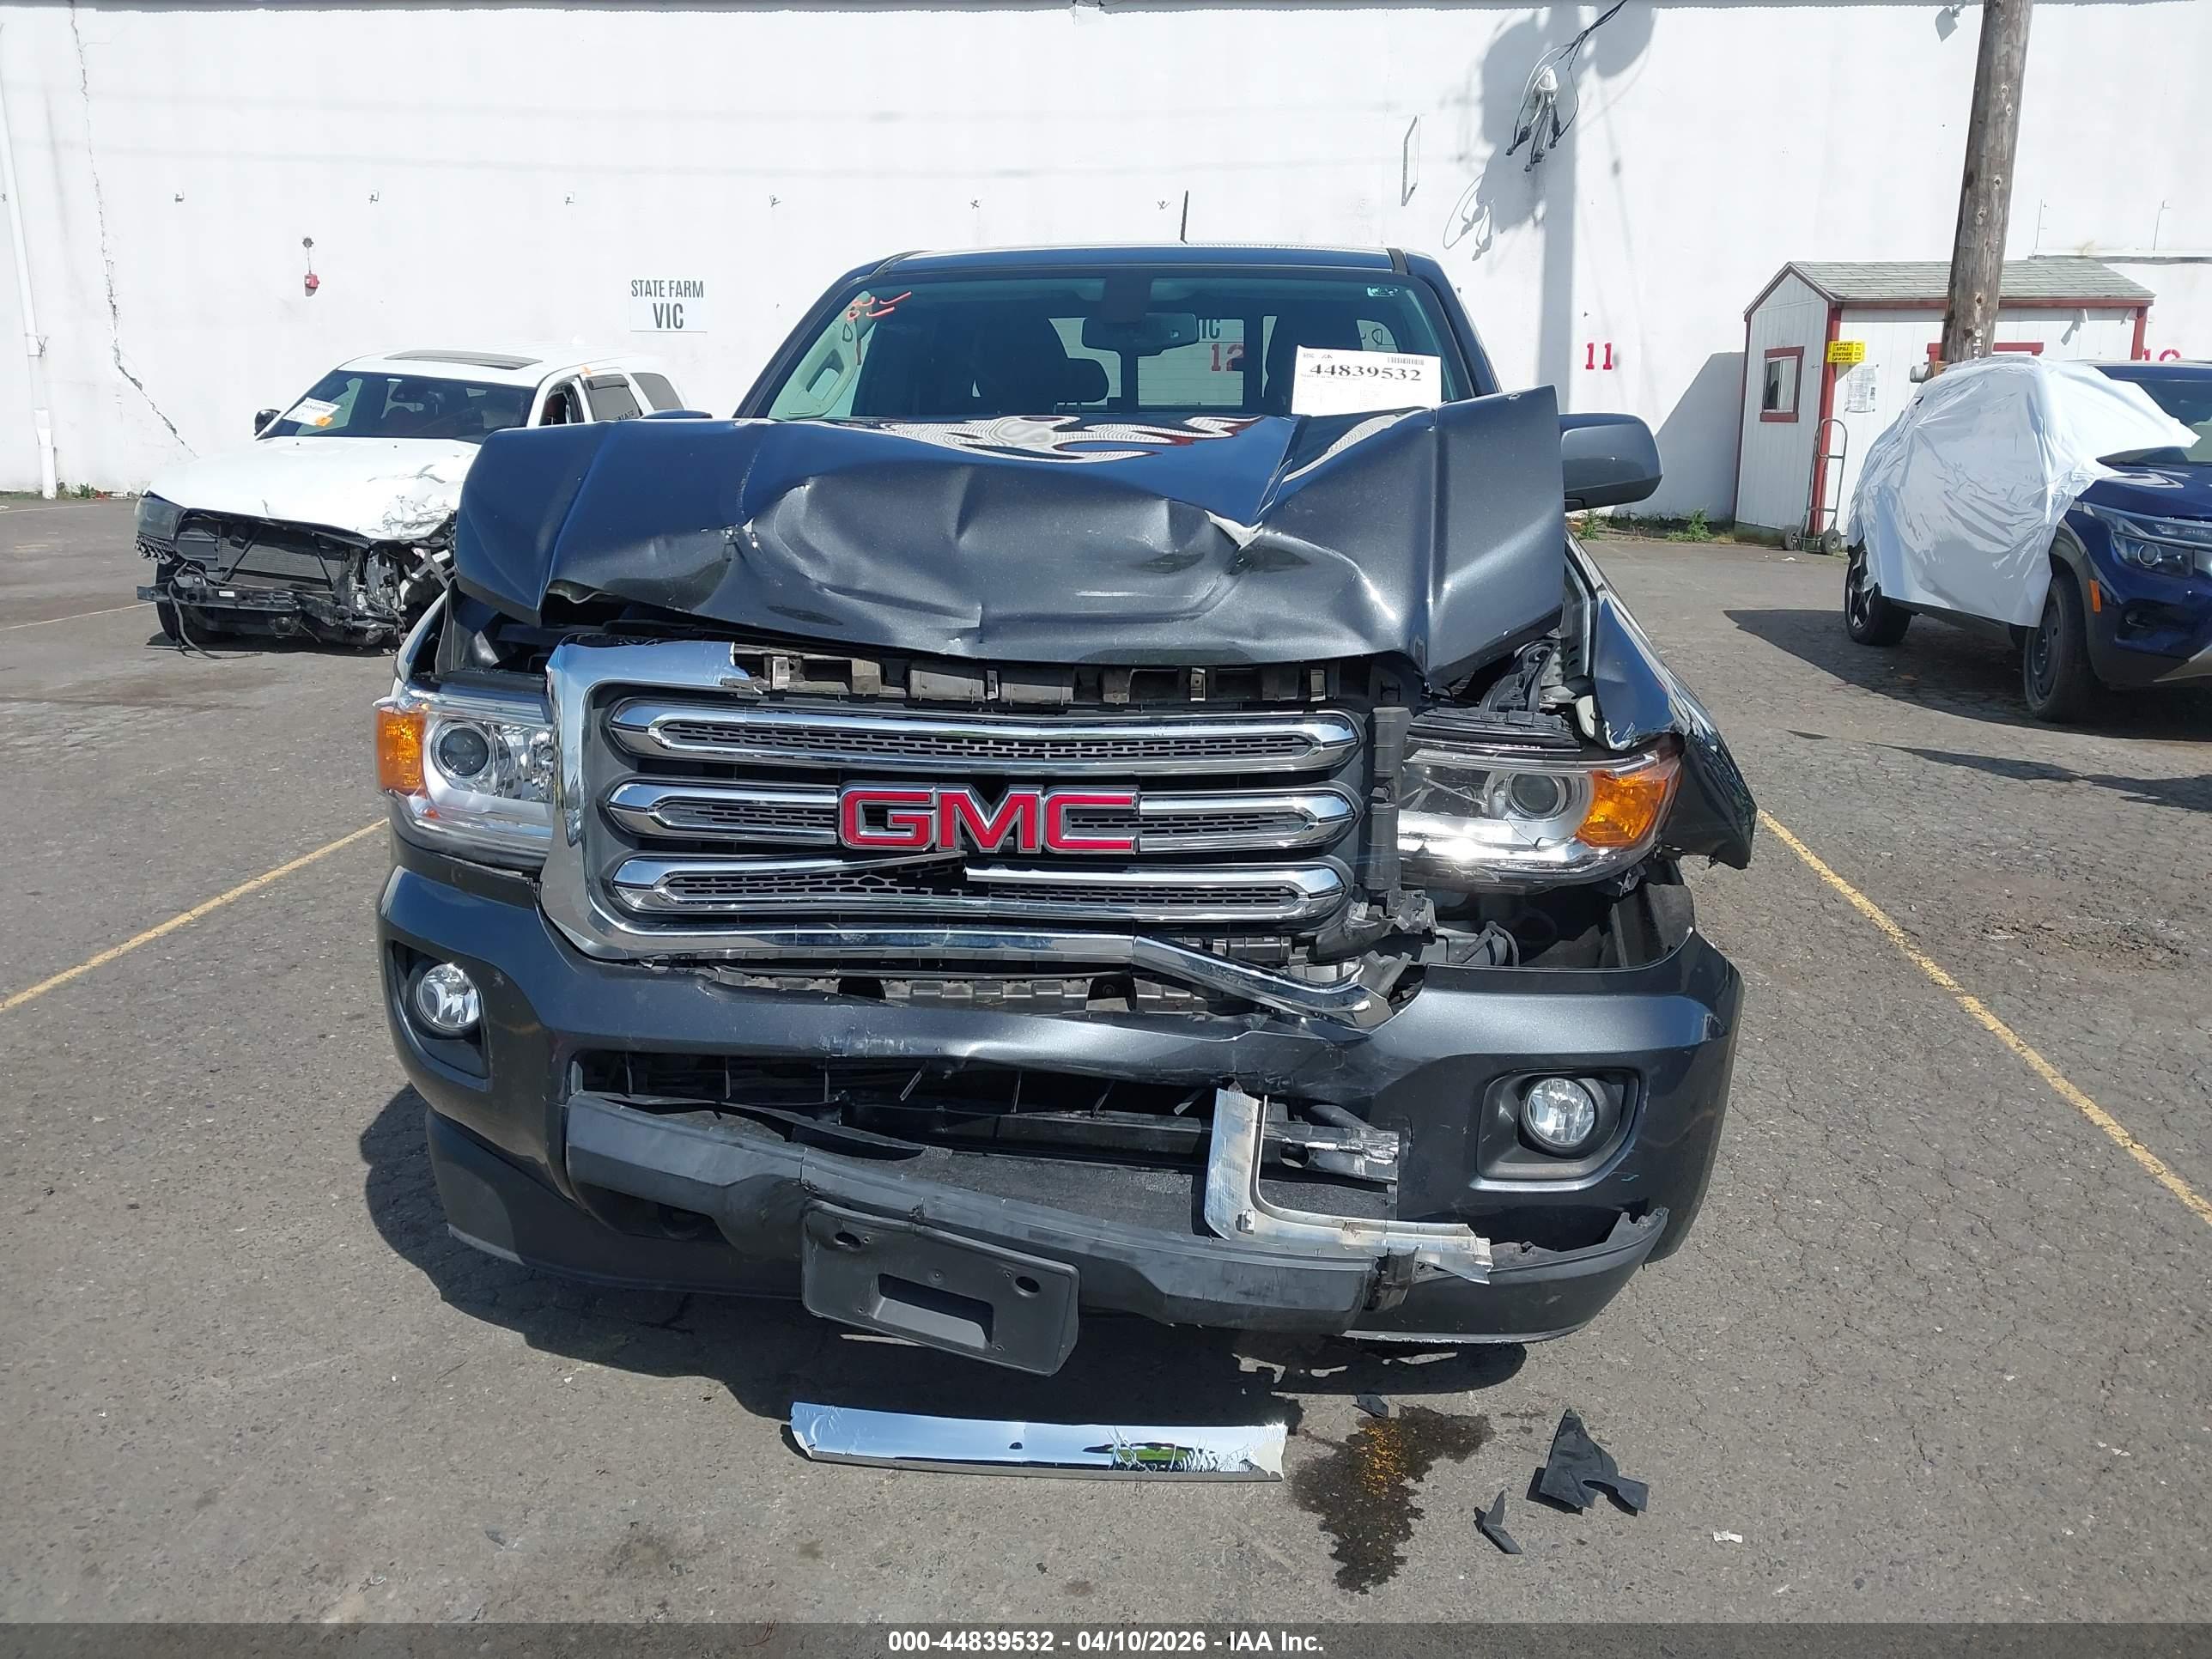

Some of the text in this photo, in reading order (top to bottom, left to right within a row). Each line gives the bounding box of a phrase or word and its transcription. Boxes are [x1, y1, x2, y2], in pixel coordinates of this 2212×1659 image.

[631, 279, 704, 299] STATE FARM
[653, 302, 684, 329] VIC
[1202, 319, 1220, 339] IC
[1586, 342, 1613, 370] 11
[1310, 363, 1422, 381] 44839532
[841, 783, 1139, 854] GMC
